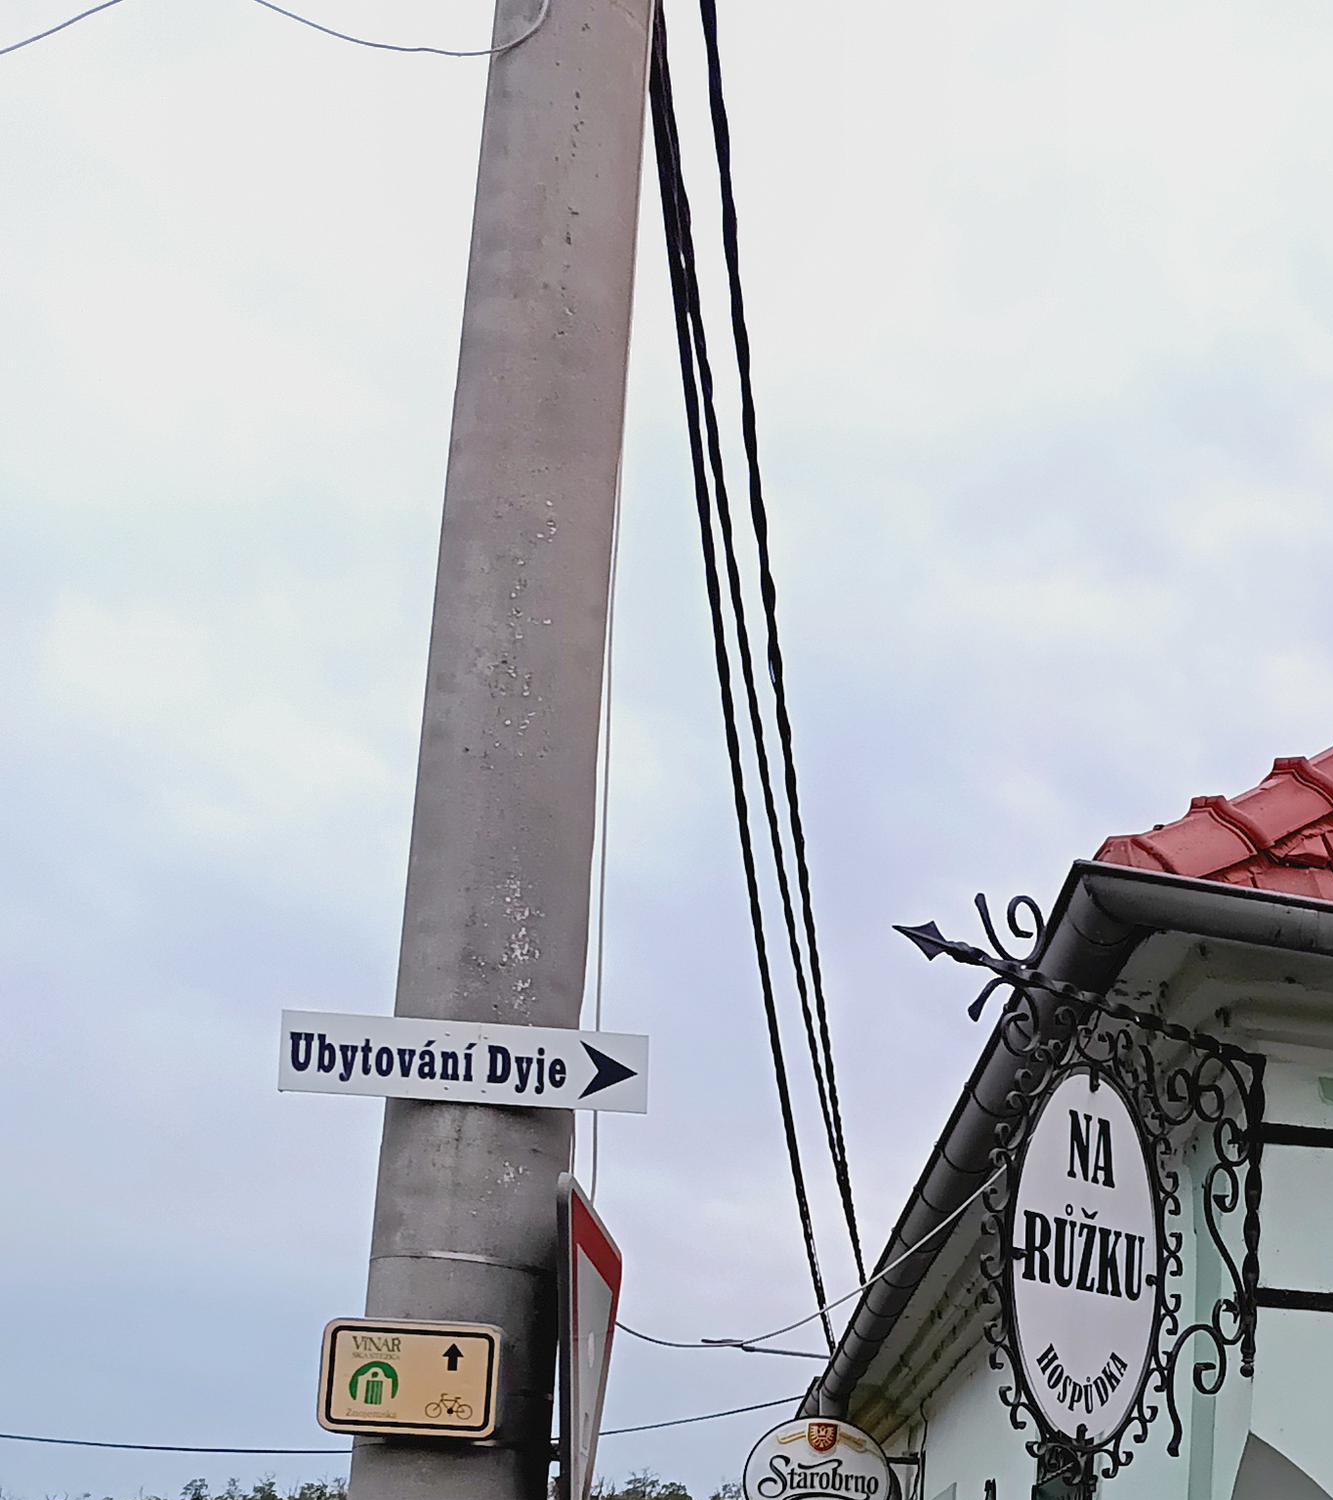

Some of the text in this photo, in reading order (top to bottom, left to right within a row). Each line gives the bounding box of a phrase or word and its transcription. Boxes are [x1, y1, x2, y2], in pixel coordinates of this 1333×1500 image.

[289, 1031, 567, 1095] Ubytování Dyje
[1067, 1109, 1116, 1189] NA
[1021, 1203, 1146, 1302] RŮŽKU
[1035, 1343, 1129, 1415] HOSPŮDKA
